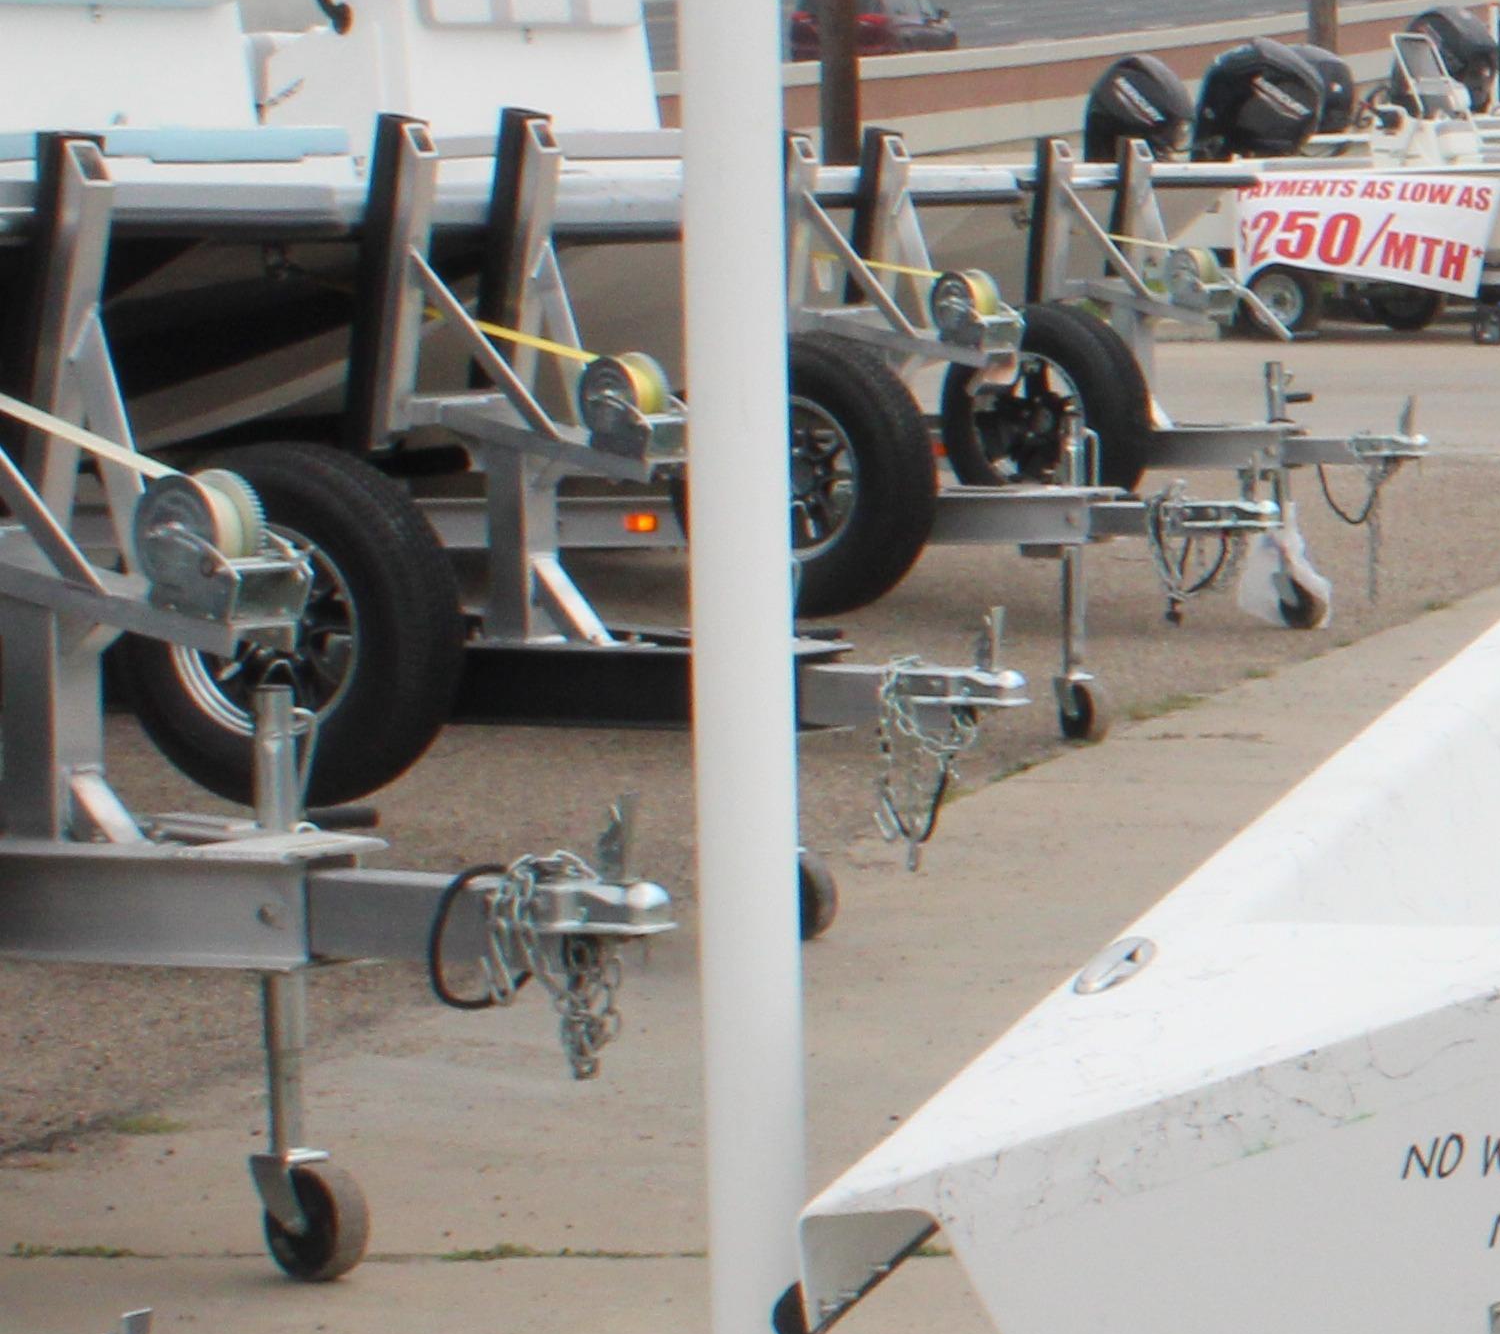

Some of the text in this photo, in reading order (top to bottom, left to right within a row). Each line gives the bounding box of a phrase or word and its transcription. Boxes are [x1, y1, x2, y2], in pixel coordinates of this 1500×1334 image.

[1359, 179, 1395, 201] AS
[1398, 182, 1453, 205] LOW
[1455, 186, 1494, 212] AS
[1400, 1132, 1465, 1180] NO
